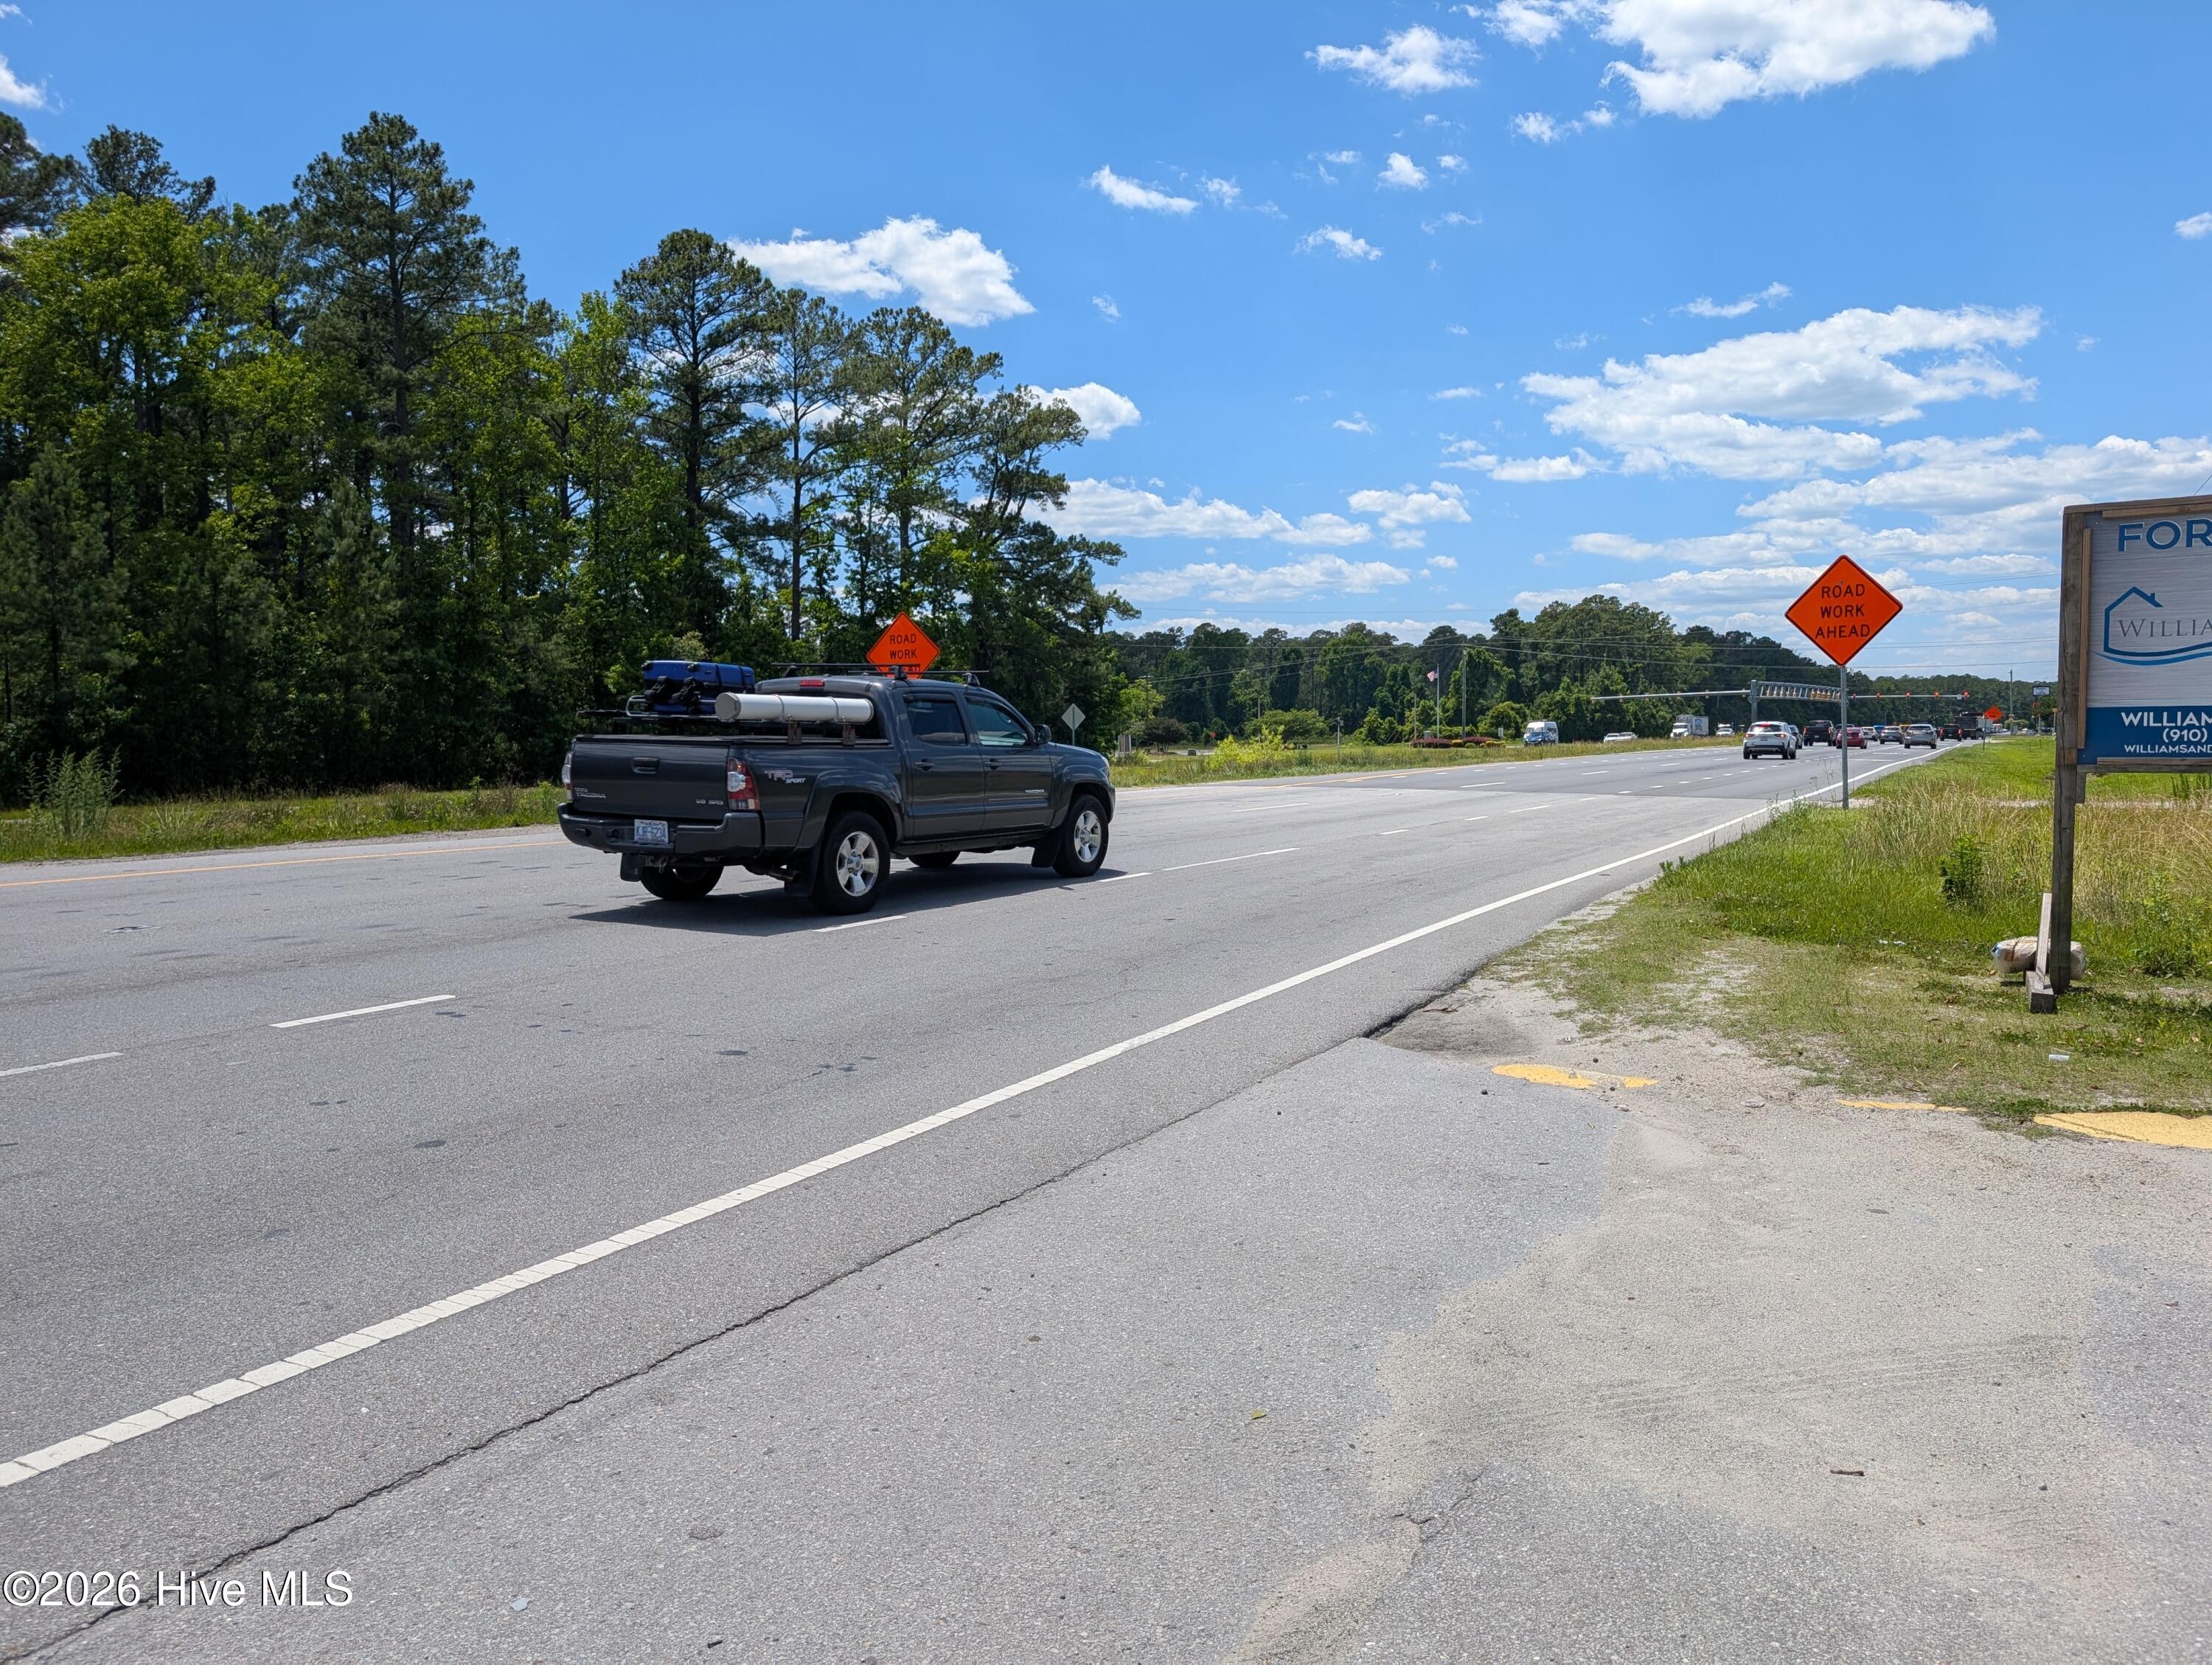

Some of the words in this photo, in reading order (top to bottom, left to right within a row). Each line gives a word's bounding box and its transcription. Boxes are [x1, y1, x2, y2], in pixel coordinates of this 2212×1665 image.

[2118, 518, 2212, 552] FOR
[1821, 584, 1865, 599] ROAD
[1820, 604, 1865, 619] WORK
[889, 634, 917, 644] ROAD
[1815, 625, 1871, 639] AHEAD
[889, 649, 917, 660] WORK
[2163, 727, 2208, 743] (910)
